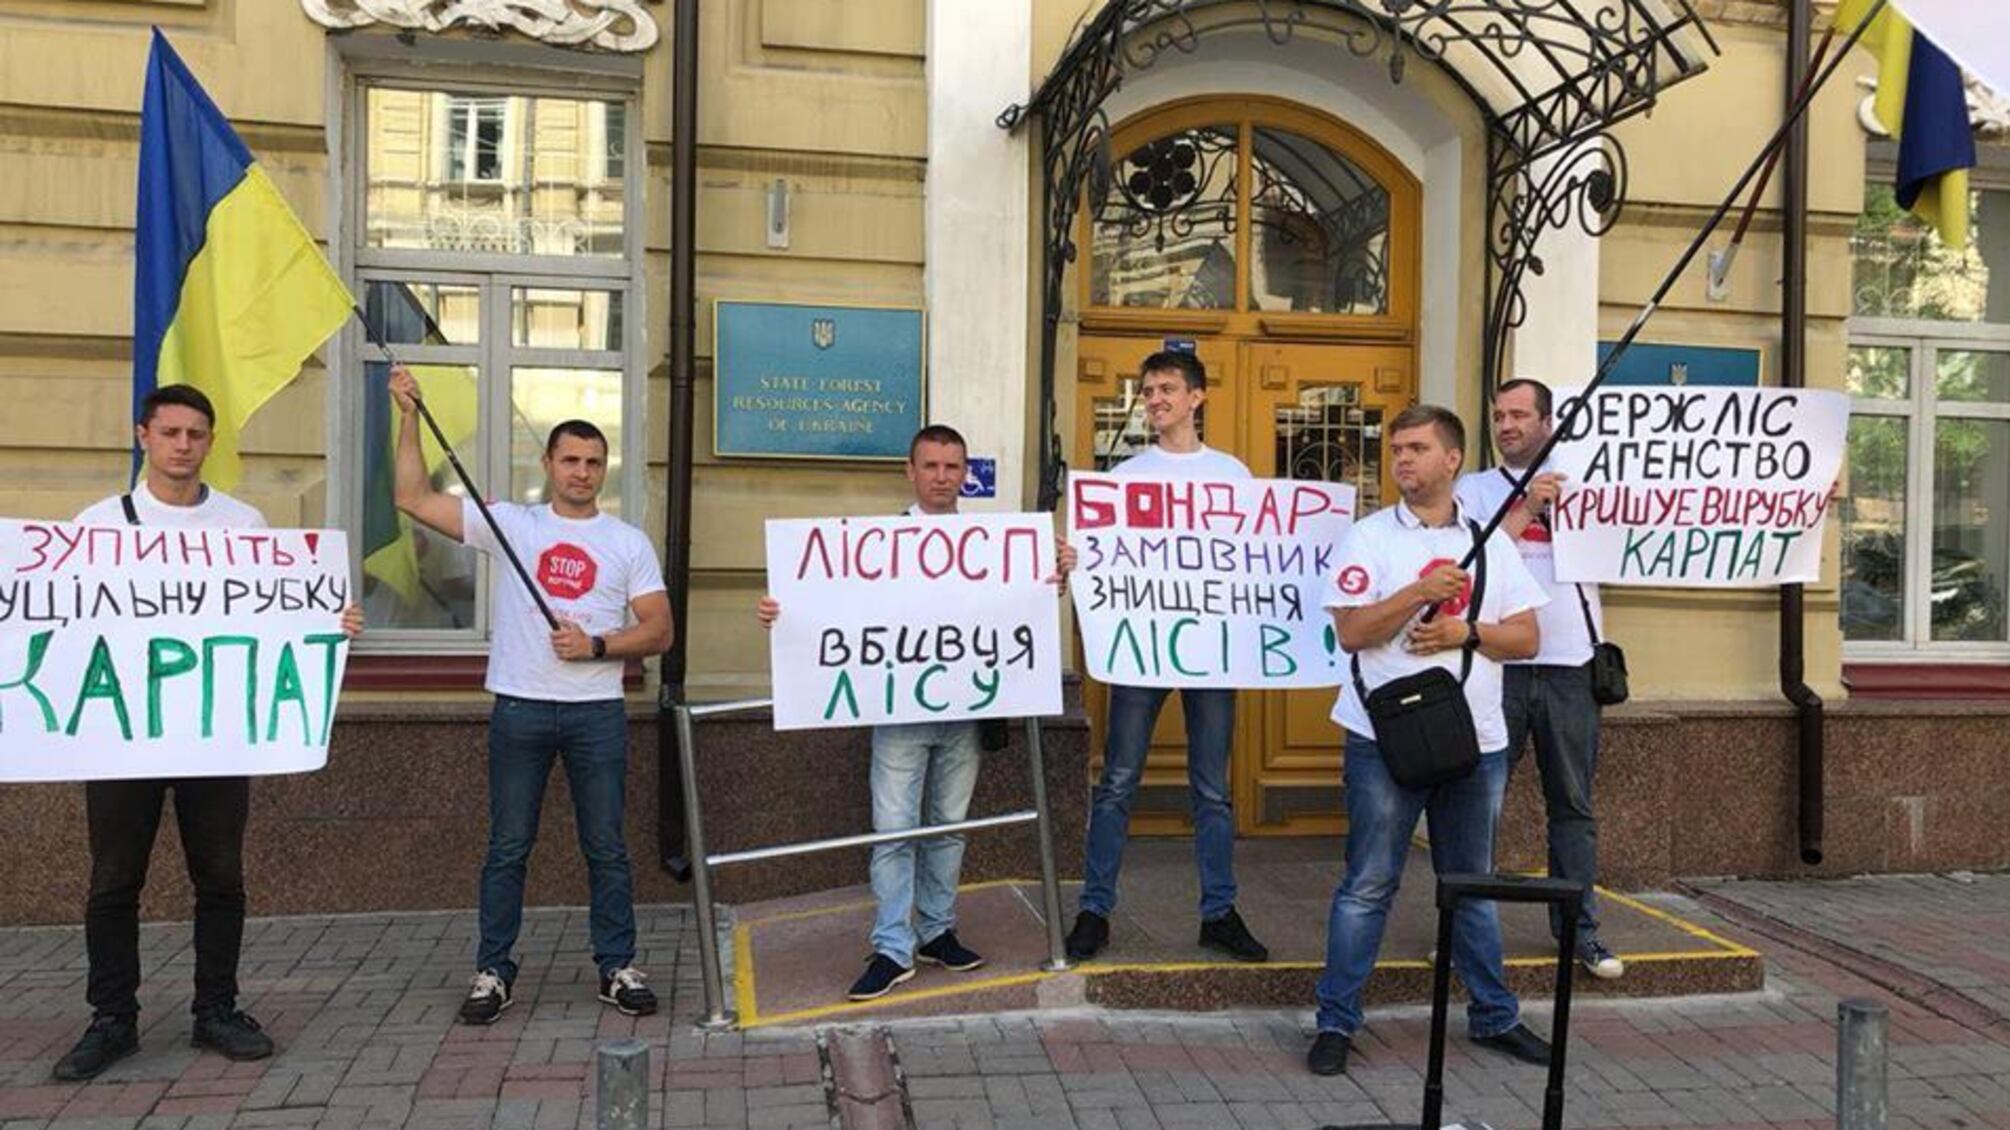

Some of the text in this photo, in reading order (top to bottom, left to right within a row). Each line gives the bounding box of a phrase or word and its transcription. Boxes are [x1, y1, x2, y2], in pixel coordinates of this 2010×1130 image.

[732, 396, 906, 414] RESOURCES AGENCY
[760, 376, 882, 393] STATE FOREST
[1583, 438, 1811, 483] АГЕНСТВО
[1074, 479, 1350, 535] БОНДАР-
[550, 556, 587, 578] STOP
[1085, 536, 1333, 576] ЗАМОВНИК
[1619, 528, 1803, 581] КАРПАТ
[224, 573, 347, 616] РУБКУ
[1090, 575, 1303, 622] ЗНИЩЕННЯ
[819, 624, 1035, 670] ВБИВЦЯ
[0, 629, 350, 747] КАРПАТ
